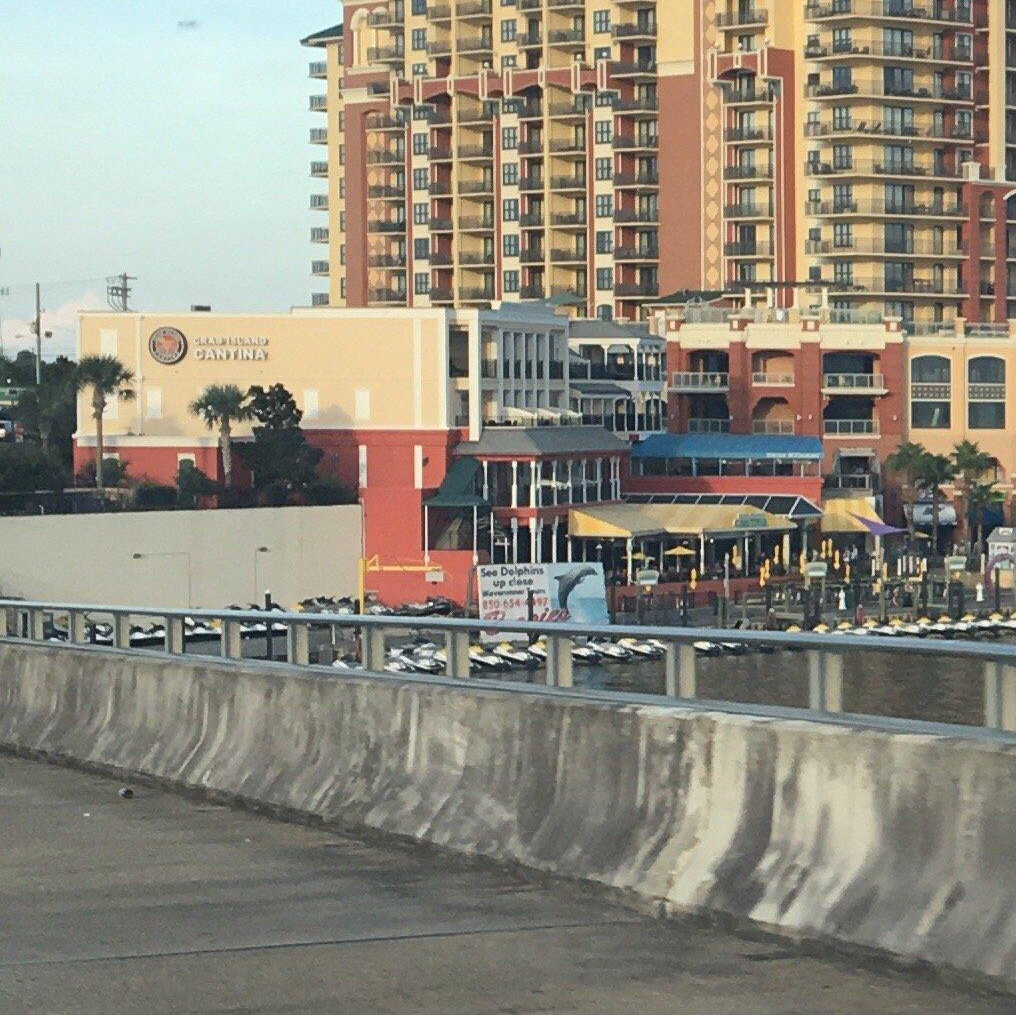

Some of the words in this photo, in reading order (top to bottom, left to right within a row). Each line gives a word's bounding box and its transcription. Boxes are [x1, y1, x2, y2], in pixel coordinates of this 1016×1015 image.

[194, 347, 269, 361] CANTINA
[481, 568, 498, 577] See
[501, 566, 544, 577] Dolphins
[493, 579, 506, 588] up
[508, 577, 534, 586] close
[482, 597, 548, 609] 850-654-97
